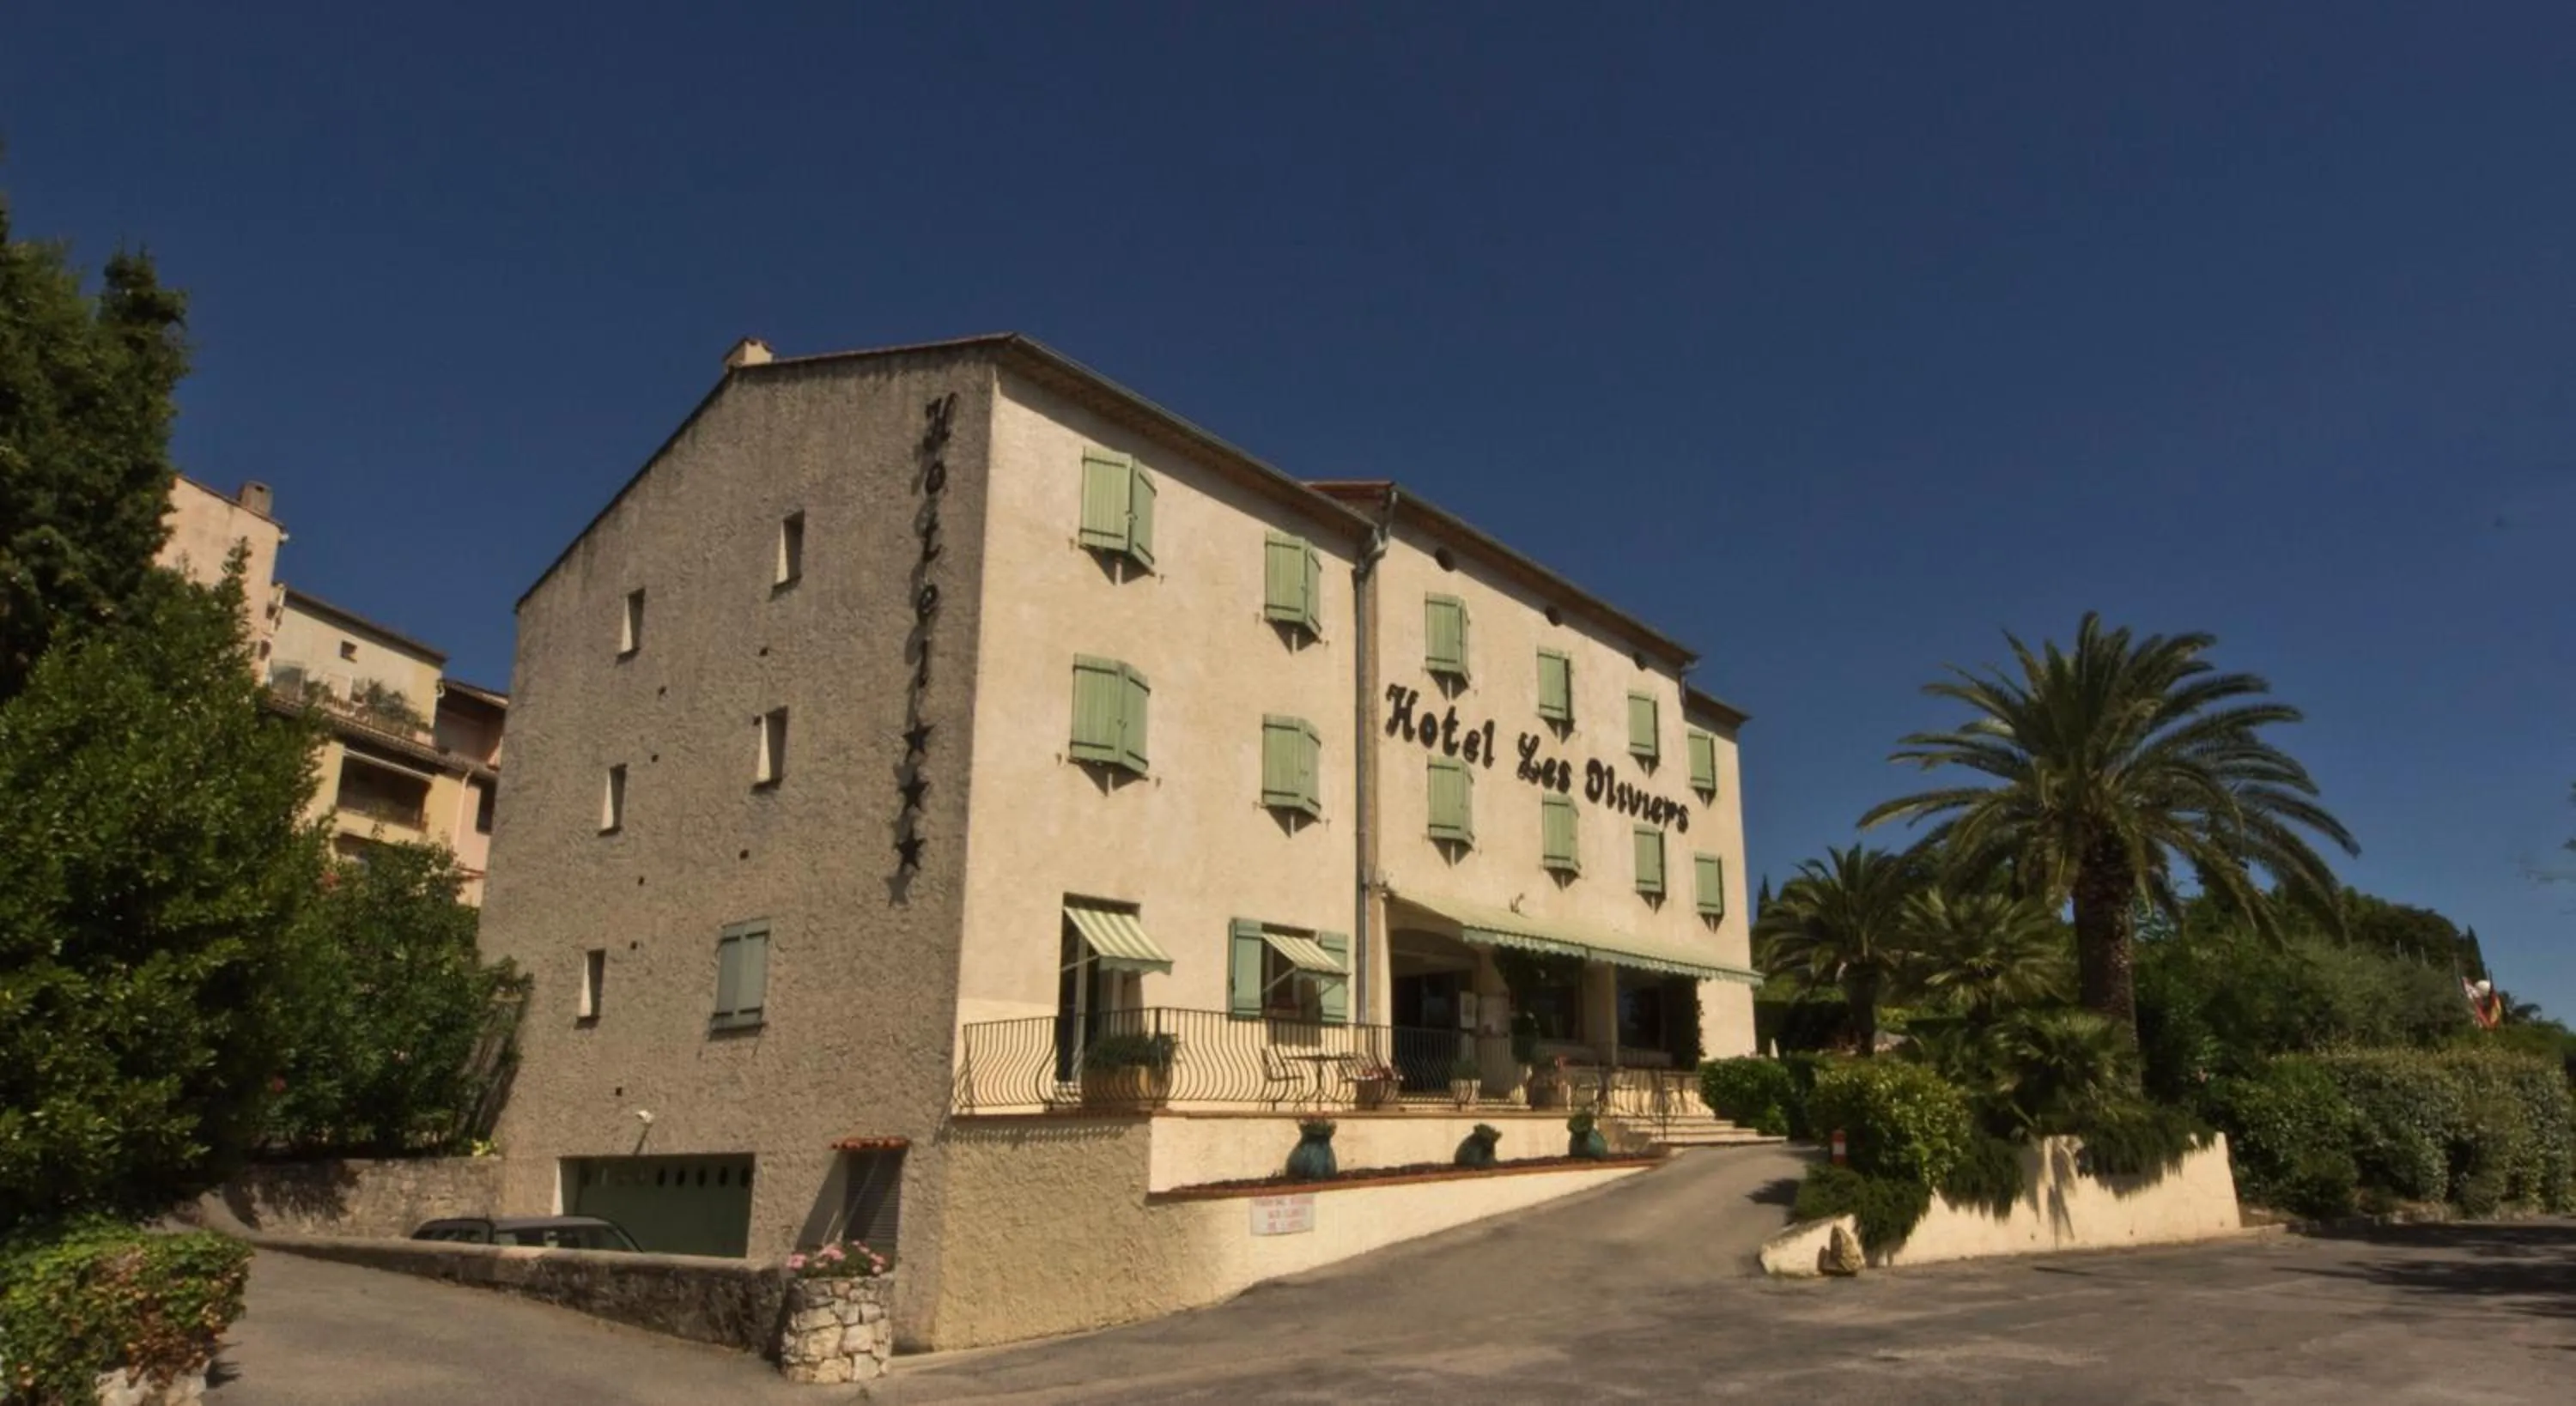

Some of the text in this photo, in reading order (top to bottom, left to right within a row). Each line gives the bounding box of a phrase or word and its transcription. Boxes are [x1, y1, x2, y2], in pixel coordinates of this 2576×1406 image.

[1385, 683, 1690, 833] Hotel Les Oliviers
